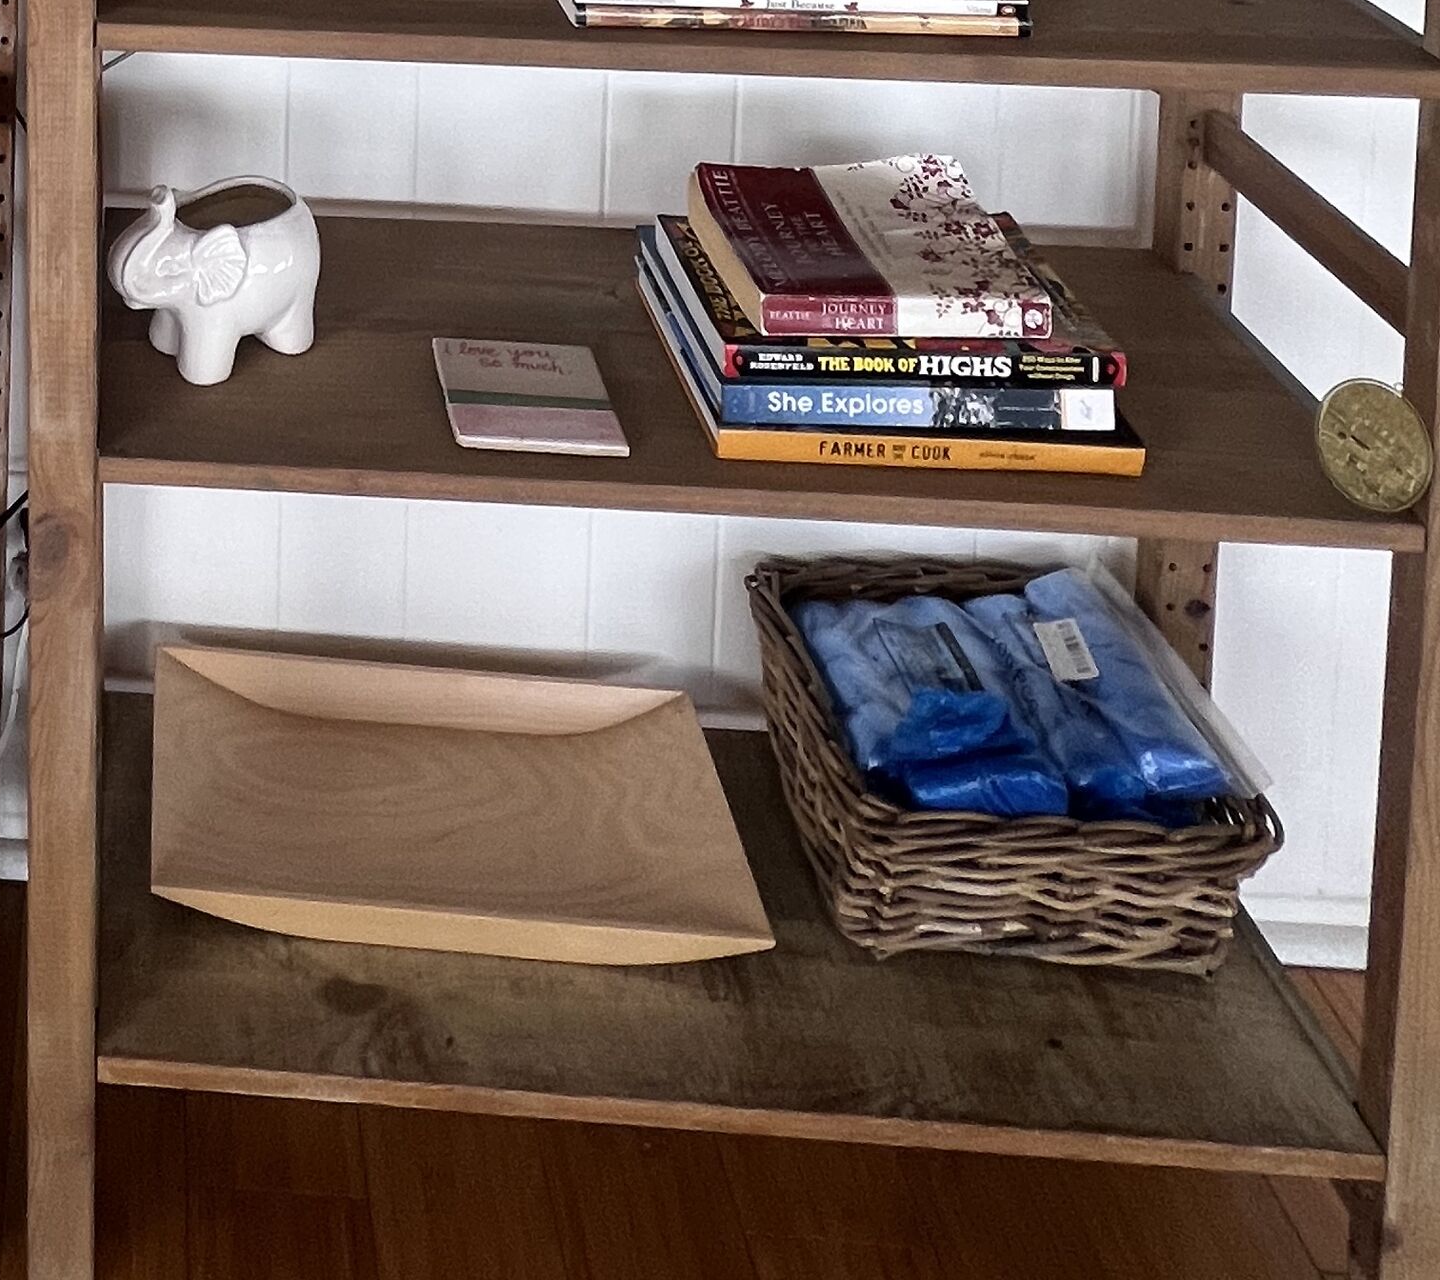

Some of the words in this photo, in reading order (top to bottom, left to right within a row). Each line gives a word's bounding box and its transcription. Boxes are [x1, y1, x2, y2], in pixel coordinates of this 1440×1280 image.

[791, 0, 835, 9] Because
[821, 303, 887, 316] JOURNEY
[835, 317, 884, 330] HEART
[459, 343, 498, 357] love
[508, 348, 550, 361] you
[758, 353, 803, 362] EDWARD
[818, 356, 850, 371] THE
[853, 357, 896, 372] BOOK
[898, 358, 918, 372] OF
[918, 355, 1012, 377] HIGHS
[768, 391, 813, 414] She
[821, 392, 925, 417] Explores
[819, 441, 886, 459] FARMER
[911, 445, 951, 461] COOK
